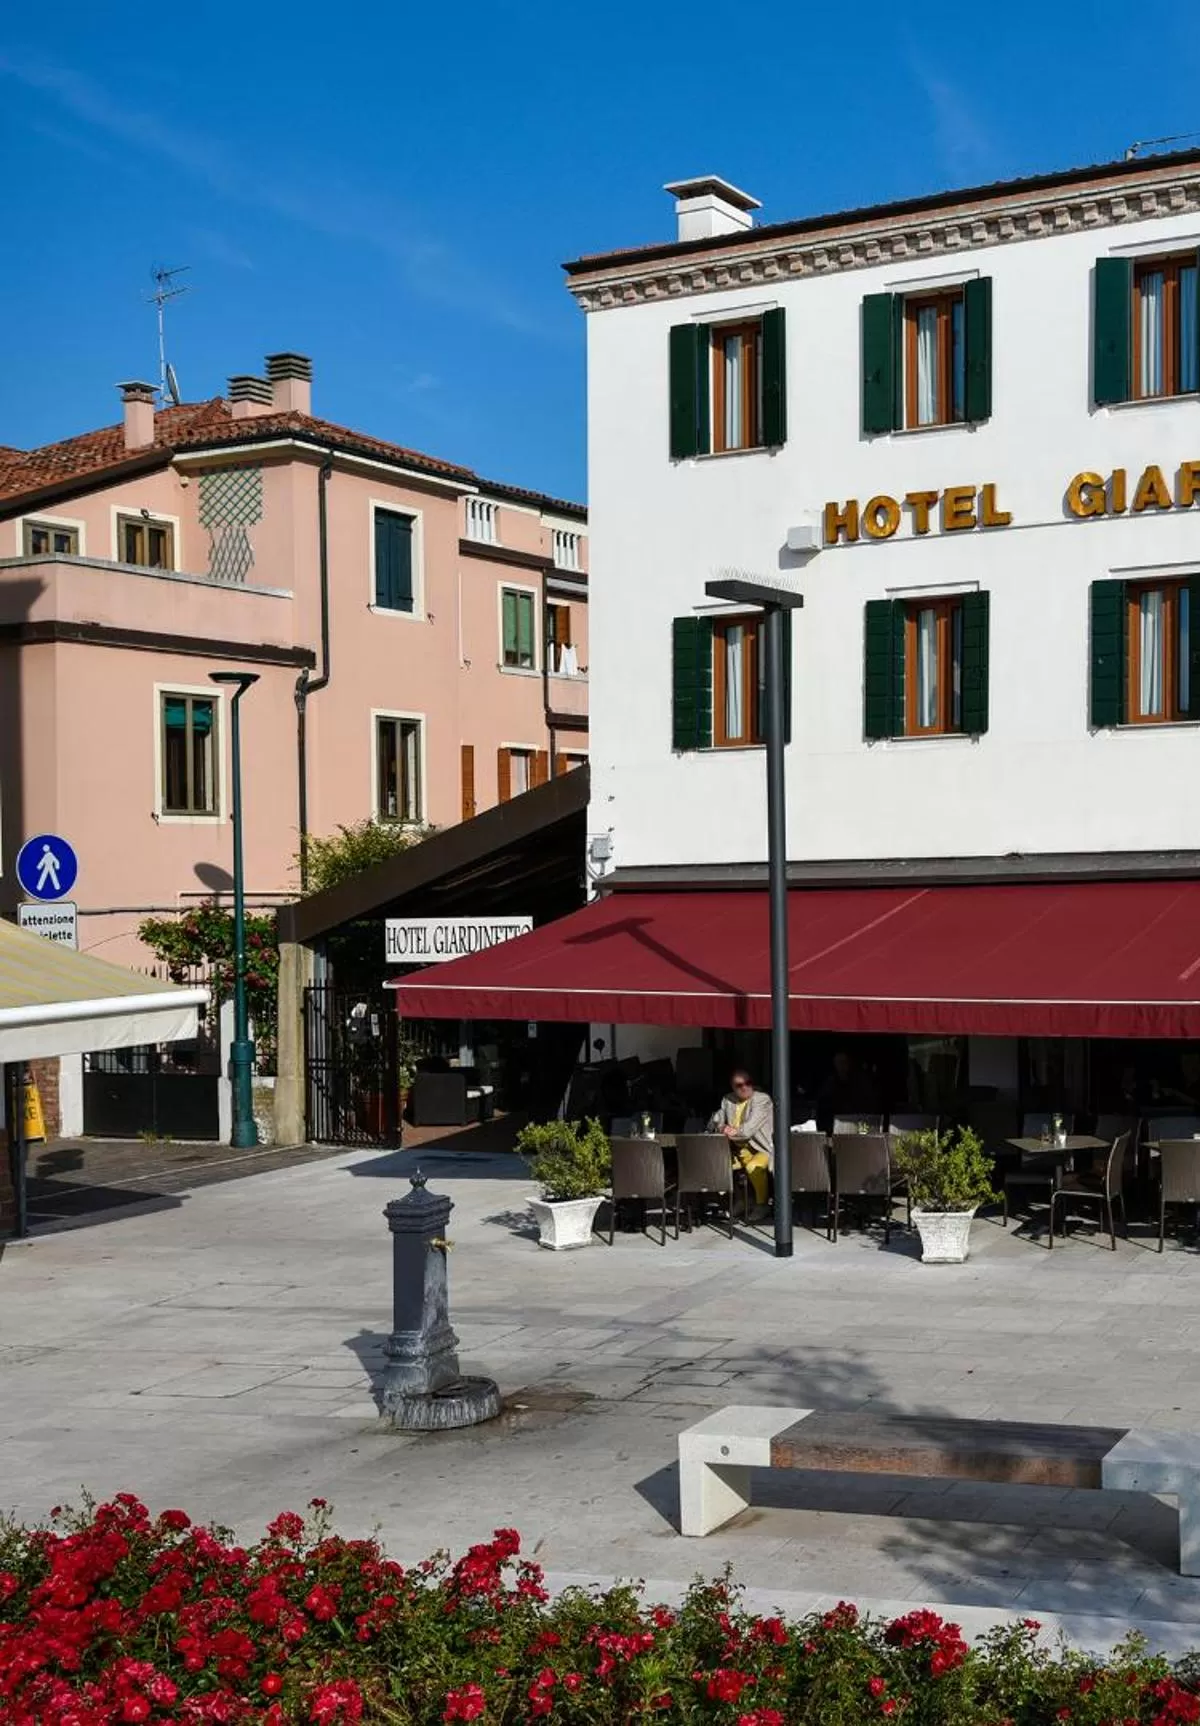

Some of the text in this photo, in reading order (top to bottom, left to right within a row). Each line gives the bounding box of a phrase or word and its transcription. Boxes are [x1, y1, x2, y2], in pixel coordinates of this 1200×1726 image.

[824, 483, 1014, 545] HOTEL
[22, 914, 74, 926] attenzione
[387, 924, 533, 954] HOTEL GIARDINET
